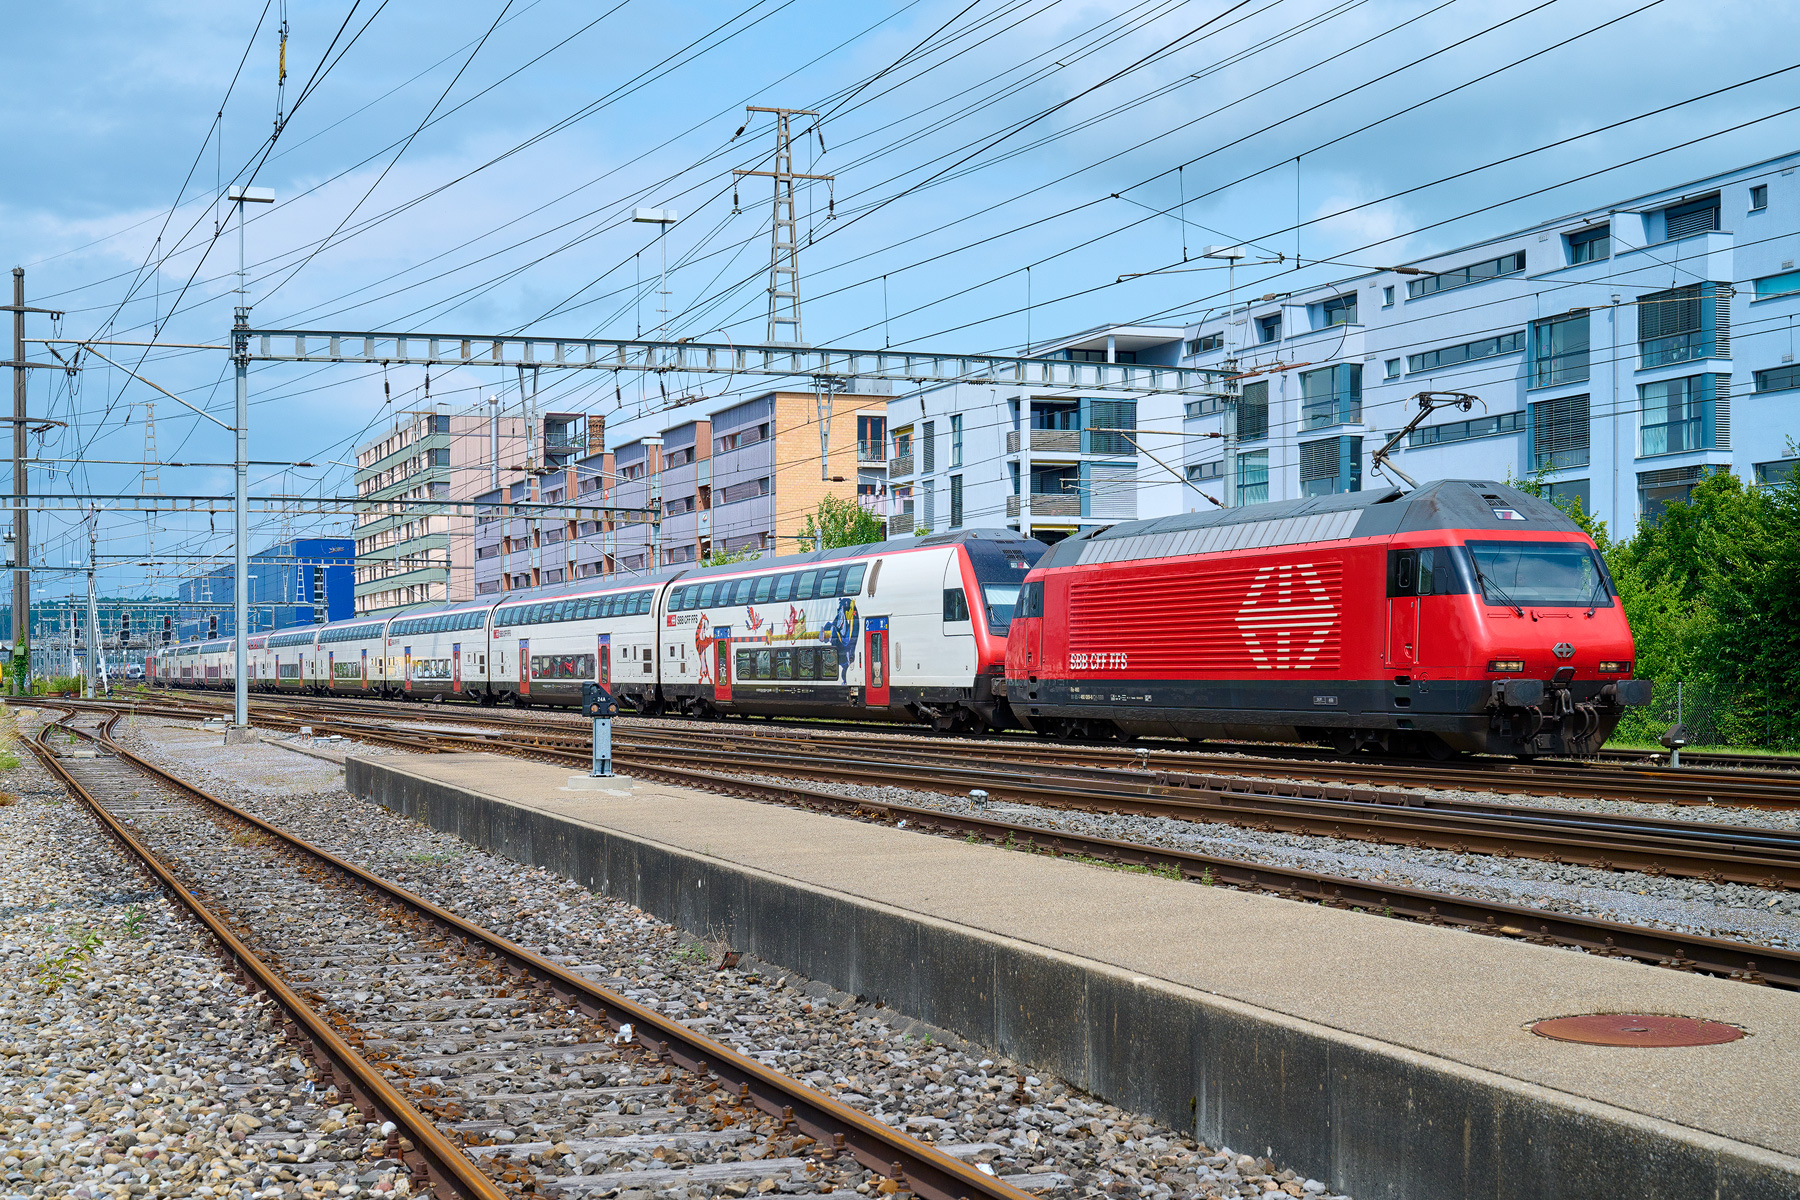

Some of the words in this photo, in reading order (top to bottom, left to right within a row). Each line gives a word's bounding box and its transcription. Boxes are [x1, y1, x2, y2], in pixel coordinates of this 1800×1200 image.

[866, 620, 869, 630] 2
[1070, 654, 1088, 670] SBB
[1090, 653, 1107, 670] CFF
[1110, 653, 1128, 670] FFS
